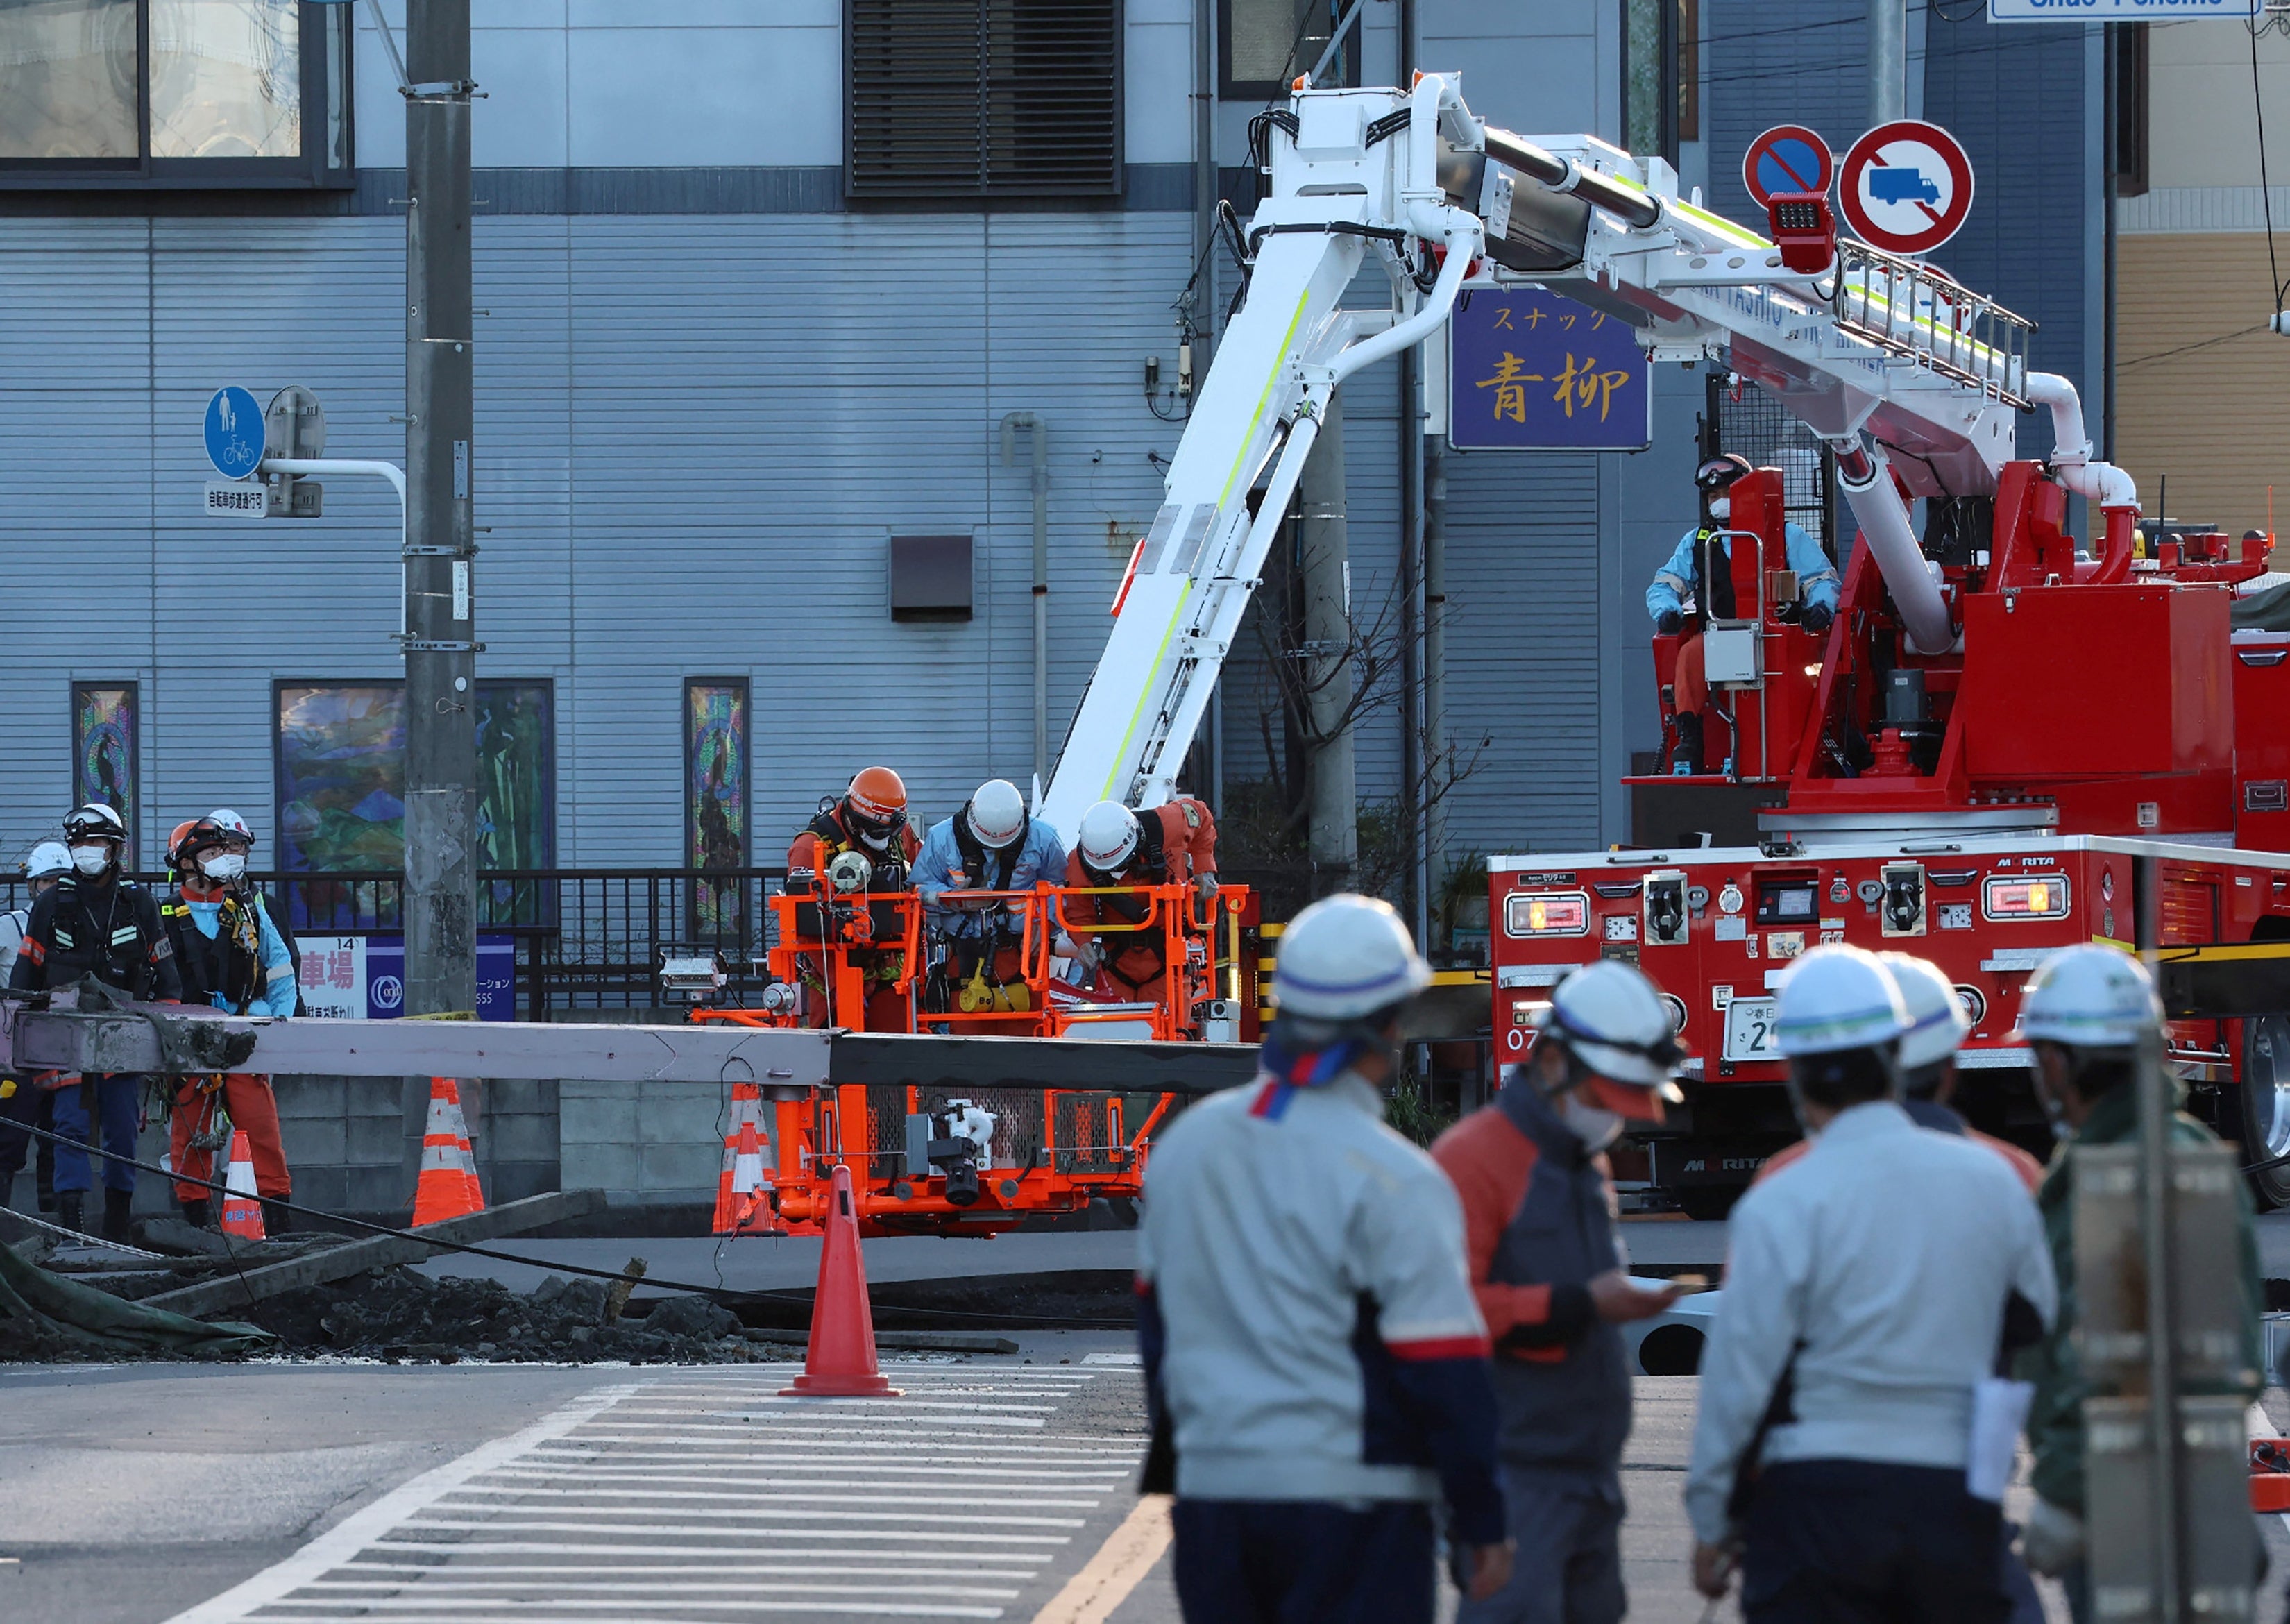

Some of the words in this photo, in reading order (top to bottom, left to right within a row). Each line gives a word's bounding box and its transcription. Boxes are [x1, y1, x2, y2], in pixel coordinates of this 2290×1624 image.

[1493, 307, 1605, 331] スナック
[1475, 351, 1629, 423] 青柳
[210, 490, 262, 509] 自転車歩道通行可
[337, 938, 354, 950] 14
[299, 951, 354, 990] 車場
[305, 1005, 354, 1019] 駐車お断わり
[1507, 1029, 1539, 1050] 07
